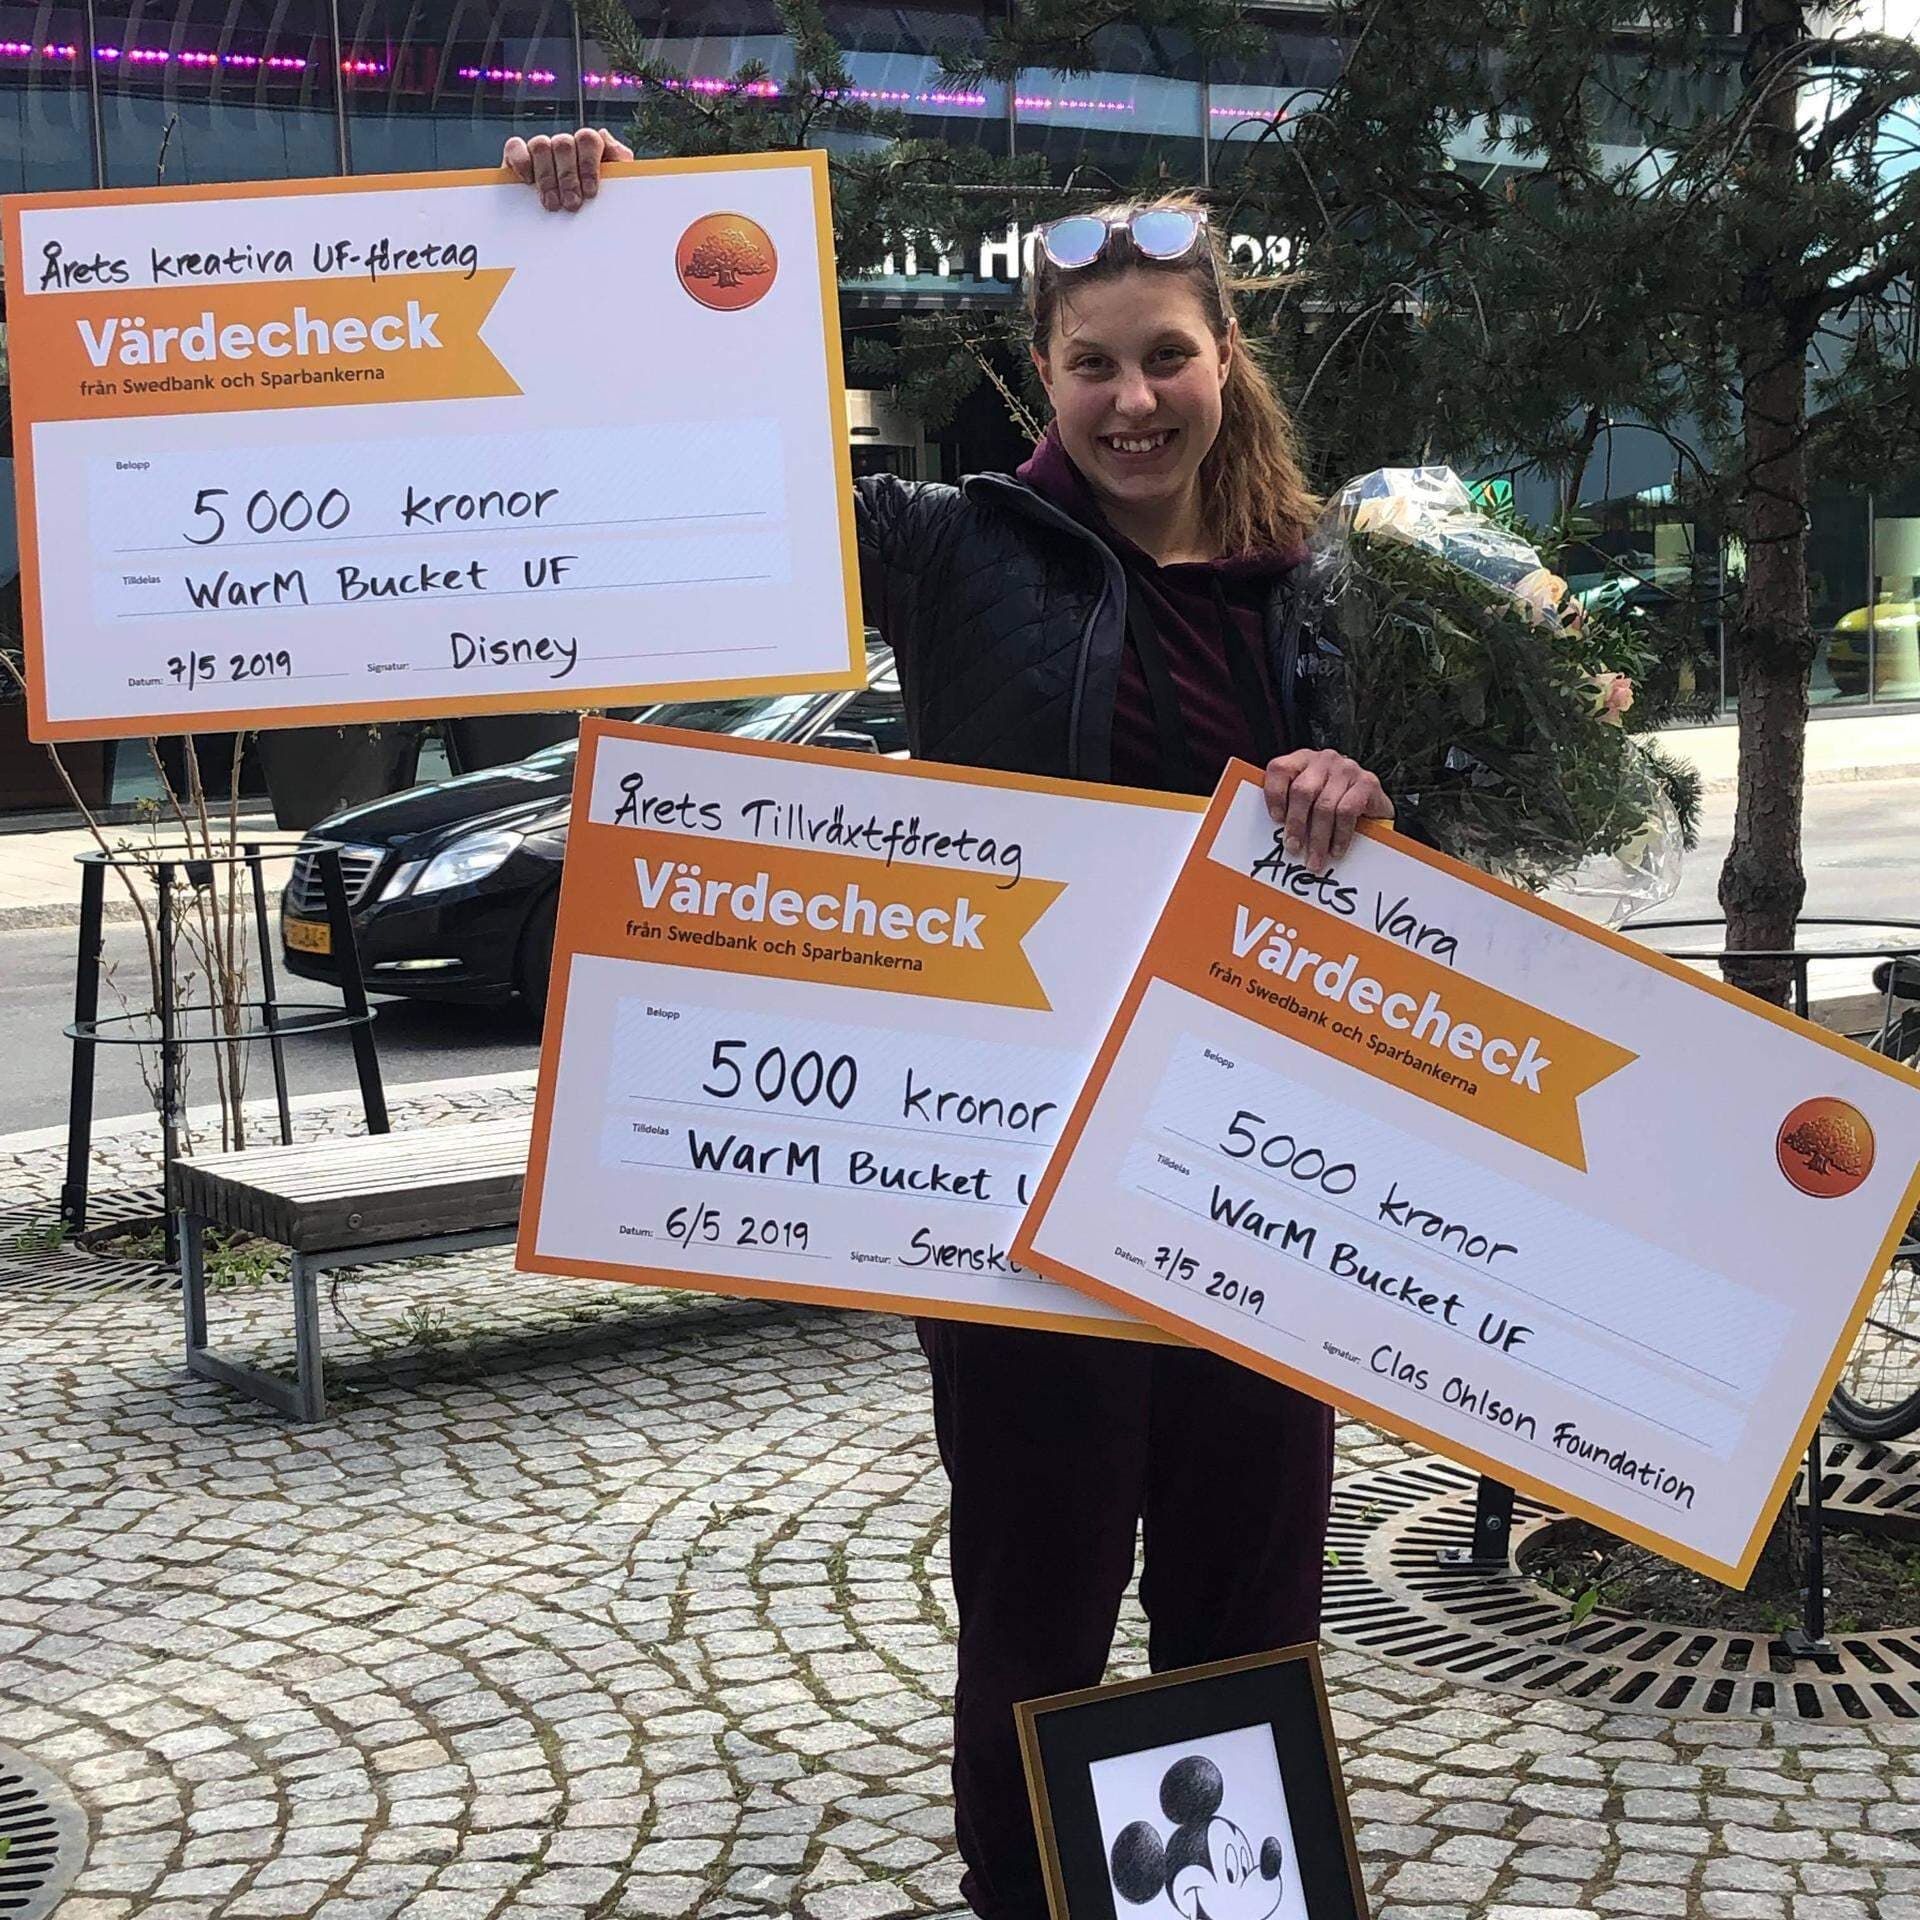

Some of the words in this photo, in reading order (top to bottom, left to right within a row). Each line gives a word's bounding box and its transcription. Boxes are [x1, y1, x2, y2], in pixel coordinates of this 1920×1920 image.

[41, 240, 129, 291] Årets
[152, 245, 293, 284] kreativa
[314, 238, 478, 282] UF-företag
[77, 300, 442, 367] Värdecheck
[80, 378, 117, 396] från
[122, 373, 214, 394] Swedbank
[221, 370, 254, 389] och
[261, 366, 385, 389] Sparbankerna
[116, 461, 150, 470] Belopp
[402, 486, 559, 528] kronor
[123, 575, 161, 585] Tilldelas
[337, 561, 488, 601] Bucket
[525, 555, 578, 588] UF
[168, 651, 216, 691] 7/5
[230, 650, 291, 681] 2019
[367, 661, 409, 674] Signatur:
[451, 632, 578, 678] Disney
[128, 676, 164, 688] Datum:
[614, 773, 721, 831] Årets
[742, 799, 1022, 890] Tillväxtföretag
[634, 858, 986, 950] Värdecheck
[626, 920, 662, 939] från
[667, 925, 757, 952] Swedbank
[764, 939, 796, 957] och
[801, 942, 923, 971] Sparbankerna
[1375, 891, 1458, 966] Vara
[647, 1006, 680, 1021] Belopp
[1231, 904, 1552, 1094] Värdecheck
[1209, 961, 1242, 988] från
[1246, 978, 1327, 1030] Swedbank
[1331, 1020, 1364, 1045] och
[1366, 1033, 1478, 1096] Sparbankerna
[1203, 1048, 1235, 1071] Belopp
[702, 1040, 857, 1109] 5000
[903, 1068, 1057, 1133] kronor
[632, 1123, 670, 1136] Tilldelas
[849, 1150, 992, 1201] Bucket
[1156, 1153, 1191, 1176] Tilldelas
[1219, 1110, 1357, 1194] 5000
[1378, 1182, 1518, 1266] kronor
[619, 1224, 654, 1238] Datum:
[666, 1202, 720, 1250] 6/5
[736, 1216, 808, 1251] 2019
[851, 1250, 892, 1265] Signatur:
[1114, 1246, 1146, 1268] Datum:
[1154, 1246, 1200, 1282] 7/5
[1205, 1271, 1266, 1316] 2019
[1328, 1243, 1468, 1327] Bucket
[1478, 1312, 1535, 1354] UF
[1322, 1341, 1361, 1365] Signatur:
[1370, 1345, 1428, 1391] Clas
[1442, 1377, 1536, 1440] Ohlson
[1553, 1422, 1697, 1509] Foundation
